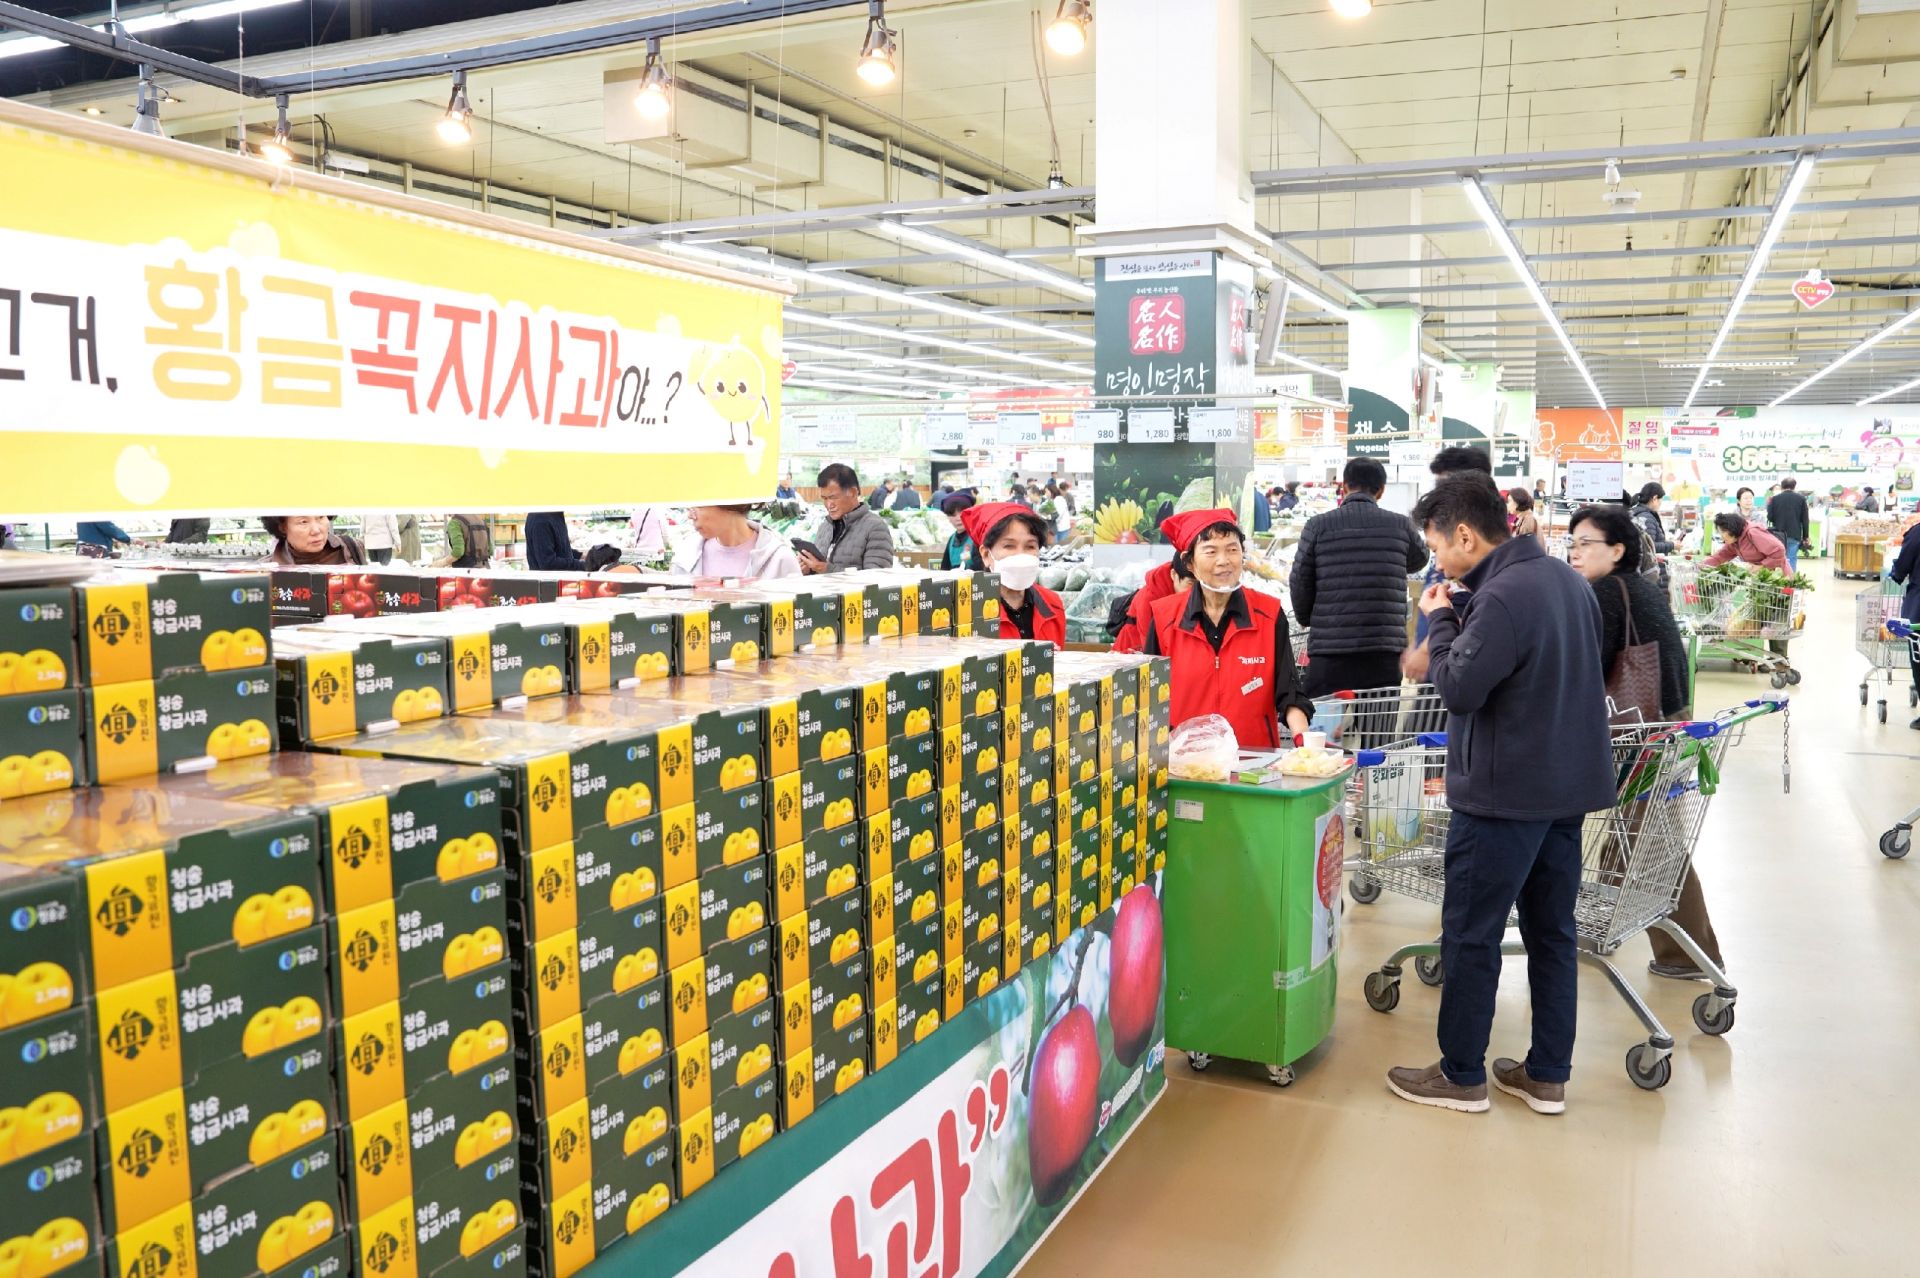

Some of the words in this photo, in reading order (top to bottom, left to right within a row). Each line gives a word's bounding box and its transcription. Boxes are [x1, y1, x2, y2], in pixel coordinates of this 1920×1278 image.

[1106, 362, 1210, 397] 명인명작
[942, 432, 963, 441] 2,880
[1021, 432, 1037, 440] 780
[1098, 430, 1114, 438] 980
[1146, 429, 1169, 439] 1,280
[1207, 429, 1232, 438] 11,800
[1628, 421, 1658, 434] 절임
[1355, 444, 1390, 453] vegetab
[1627, 438, 1658, 451] 배추
[152, 599, 177, 616] 청송
[153, 615, 202, 635] 황금사과
[37, 670, 63, 682] 2.5kg
[159, 695, 183, 712] 청송
[159, 709, 208, 731] 황금사과
[44, 770, 71, 783] 2.5kg
[572, 763, 589, 780] 청송
[573, 776, 607, 797] 황금사과
[391, 811, 415, 831] 청송
[392, 824, 437, 851] 황금사과
[577, 852, 594, 869] 청송
[171, 865, 202, 889] 청송
[577, 862, 611, 886] 황금사과
[172, 880, 234, 913] 황금사과
[398, 911, 421, 931] 청송
[399, 922, 444, 951] 황금사과
[580, 937, 597, 955] 청송
[580, 946, 614, 972] 황금사과
[36, 987, 70, 1005] 2.5kg
[181, 984, 212, 1009] 청송
[182, 996, 243, 1032] 황금사과
[404, 1010, 426, 1032] 청송
[404, 1020, 449, 1051] 황금사과
[585, 1022, 602, 1040] 청송
[586, 1029, 619, 1056] 황금사과
[189, 1096, 219, 1122] 청송
[411, 1107, 433, 1129] 청송
[591, 1104, 607, 1123] 청송
[45, 1114, 78, 1133] 2.5kg
[191, 1104, 249, 1145] 황금사과
[412, 1115, 455, 1148] 황금사과
[592, 1110, 624, 1139] 황금사과
[594, 1184, 610, 1204] 청송
[595, 1189, 627, 1220] 황금사과
[198, 1205, 227, 1232] 청송
[417, 1202, 439, 1225] 청송
[199, 1211, 257, 1254] 황금사과
[418, 1207, 461, 1244] 황금사과
[51, 1238, 85, 1260] 2.5kg
